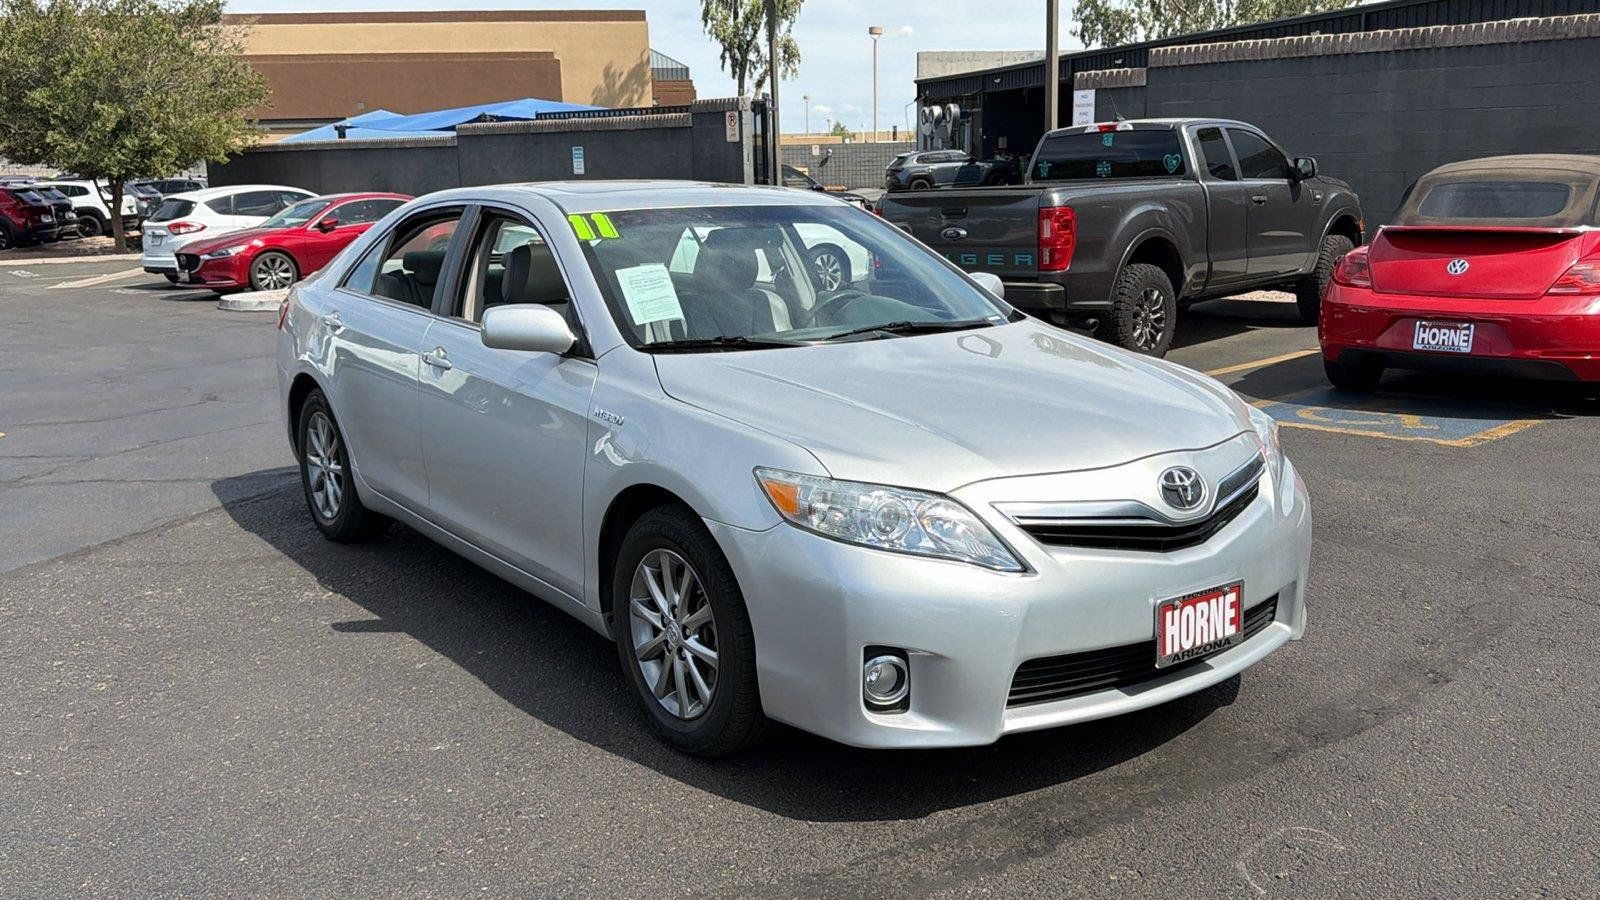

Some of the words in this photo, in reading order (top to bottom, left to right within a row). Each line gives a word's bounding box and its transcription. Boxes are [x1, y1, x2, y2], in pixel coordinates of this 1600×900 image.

[568, 213, 619, 240] 11
[946, 253, 1033, 266] GER
[1418, 327, 1470, 347] HORNE
[1165, 592, 1237, 656] HORNE
[1171, 638, 1231, 663] ARIZONA
